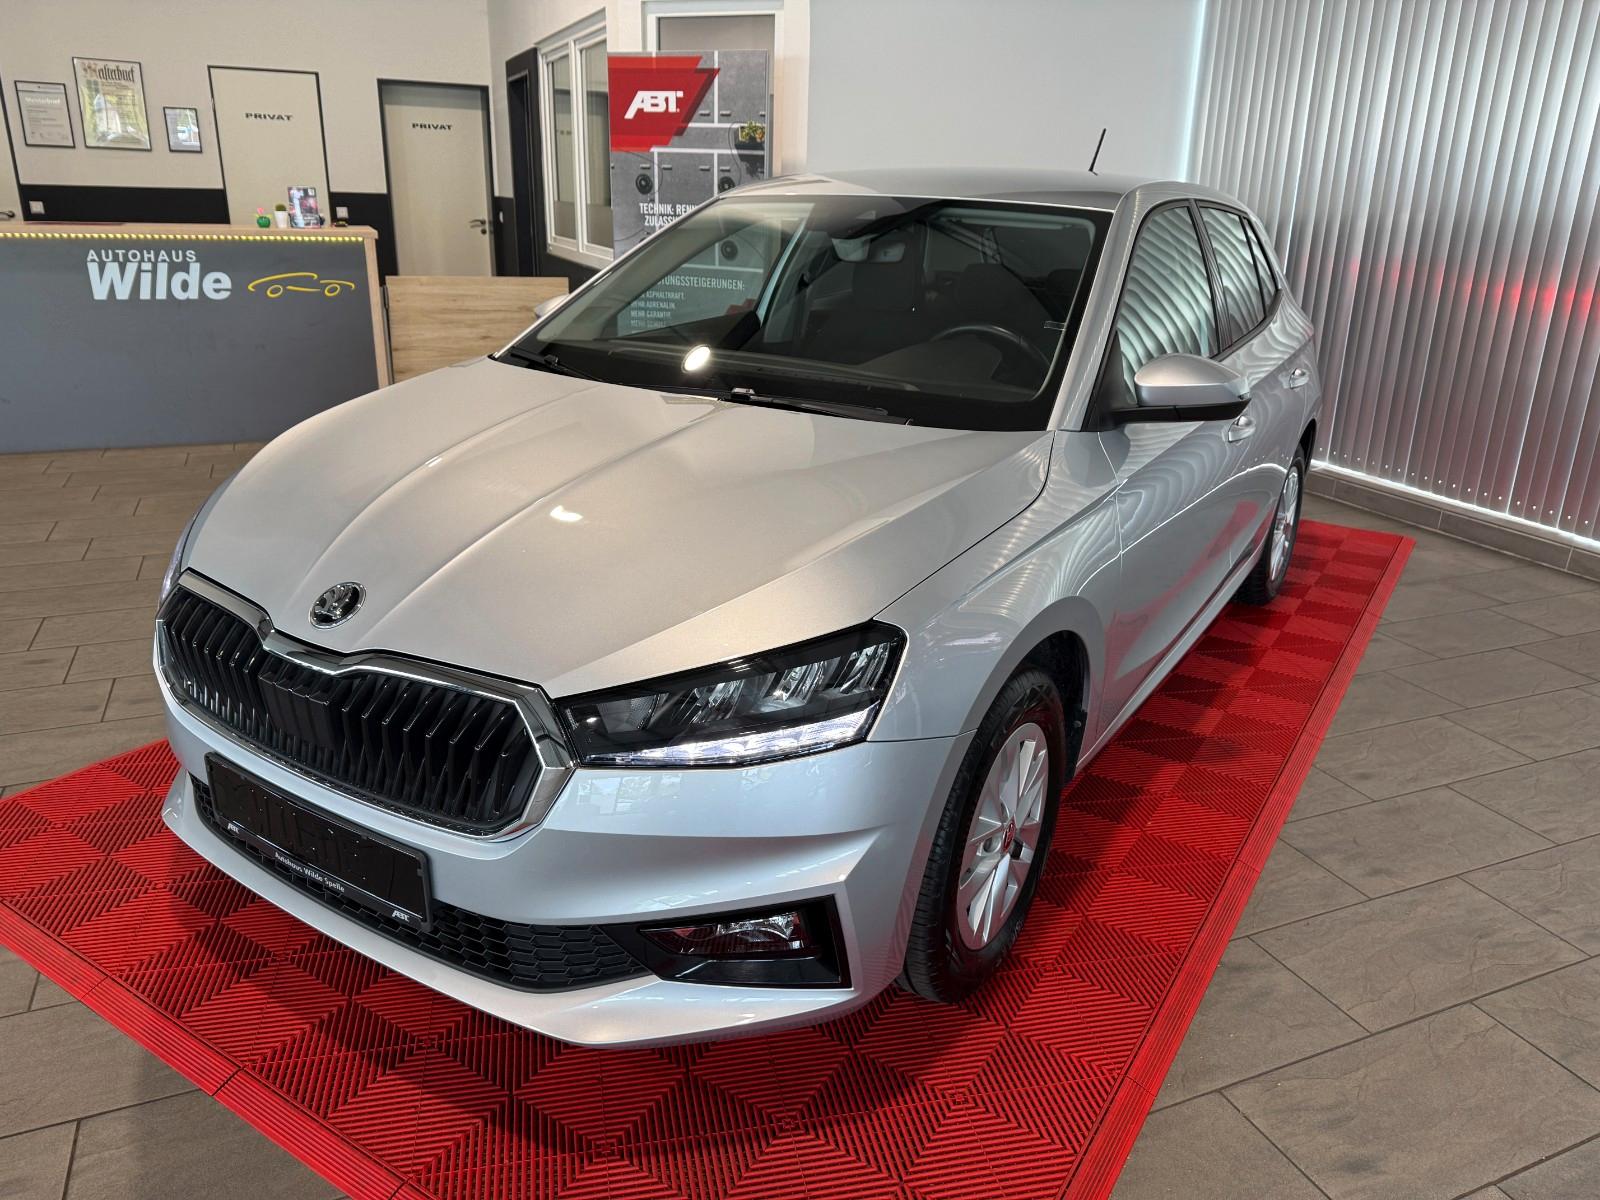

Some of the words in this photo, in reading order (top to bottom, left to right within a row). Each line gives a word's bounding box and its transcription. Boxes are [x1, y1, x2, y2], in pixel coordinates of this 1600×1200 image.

[245, 112, 293, 121] PRIVAT
[87, 249, 197, 262] AUTOHAUS
[86, 261, 232, 300] Wilde
[303, 867, 323, 882] Wilde
[323, 877, 345, 893] Spelle
